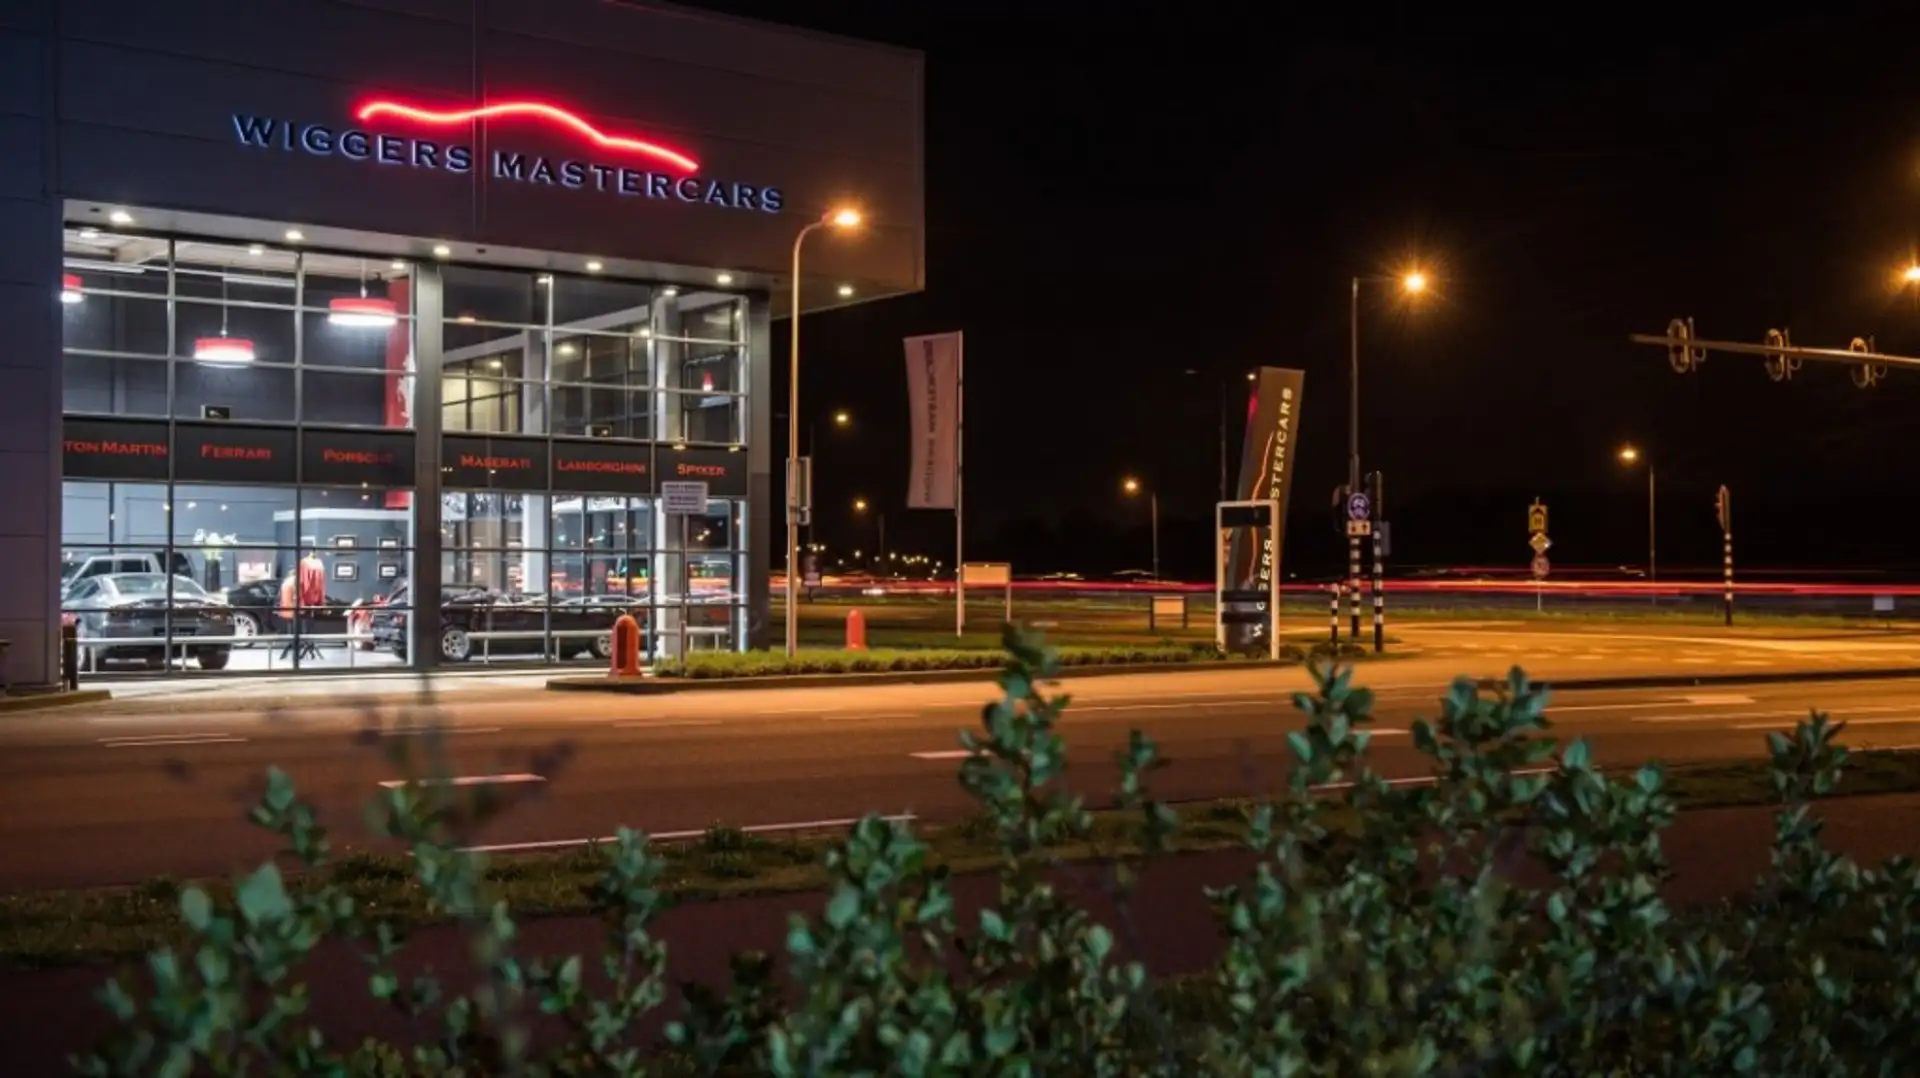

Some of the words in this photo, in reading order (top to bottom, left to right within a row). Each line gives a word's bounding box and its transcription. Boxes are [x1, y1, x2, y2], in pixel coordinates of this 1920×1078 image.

[232, 112, 473, 174] WIGGERS
[492, 149, 784, 214] MASTERCARS
[62, 440, 99, 454] TON
[102, 440, 168, 457] MARTIN
[201, 442, 272, 460] FERRARI
[1252, 538, 1273, 637] WGGERS
[1268, 386, 1294, 500] STERCARS
